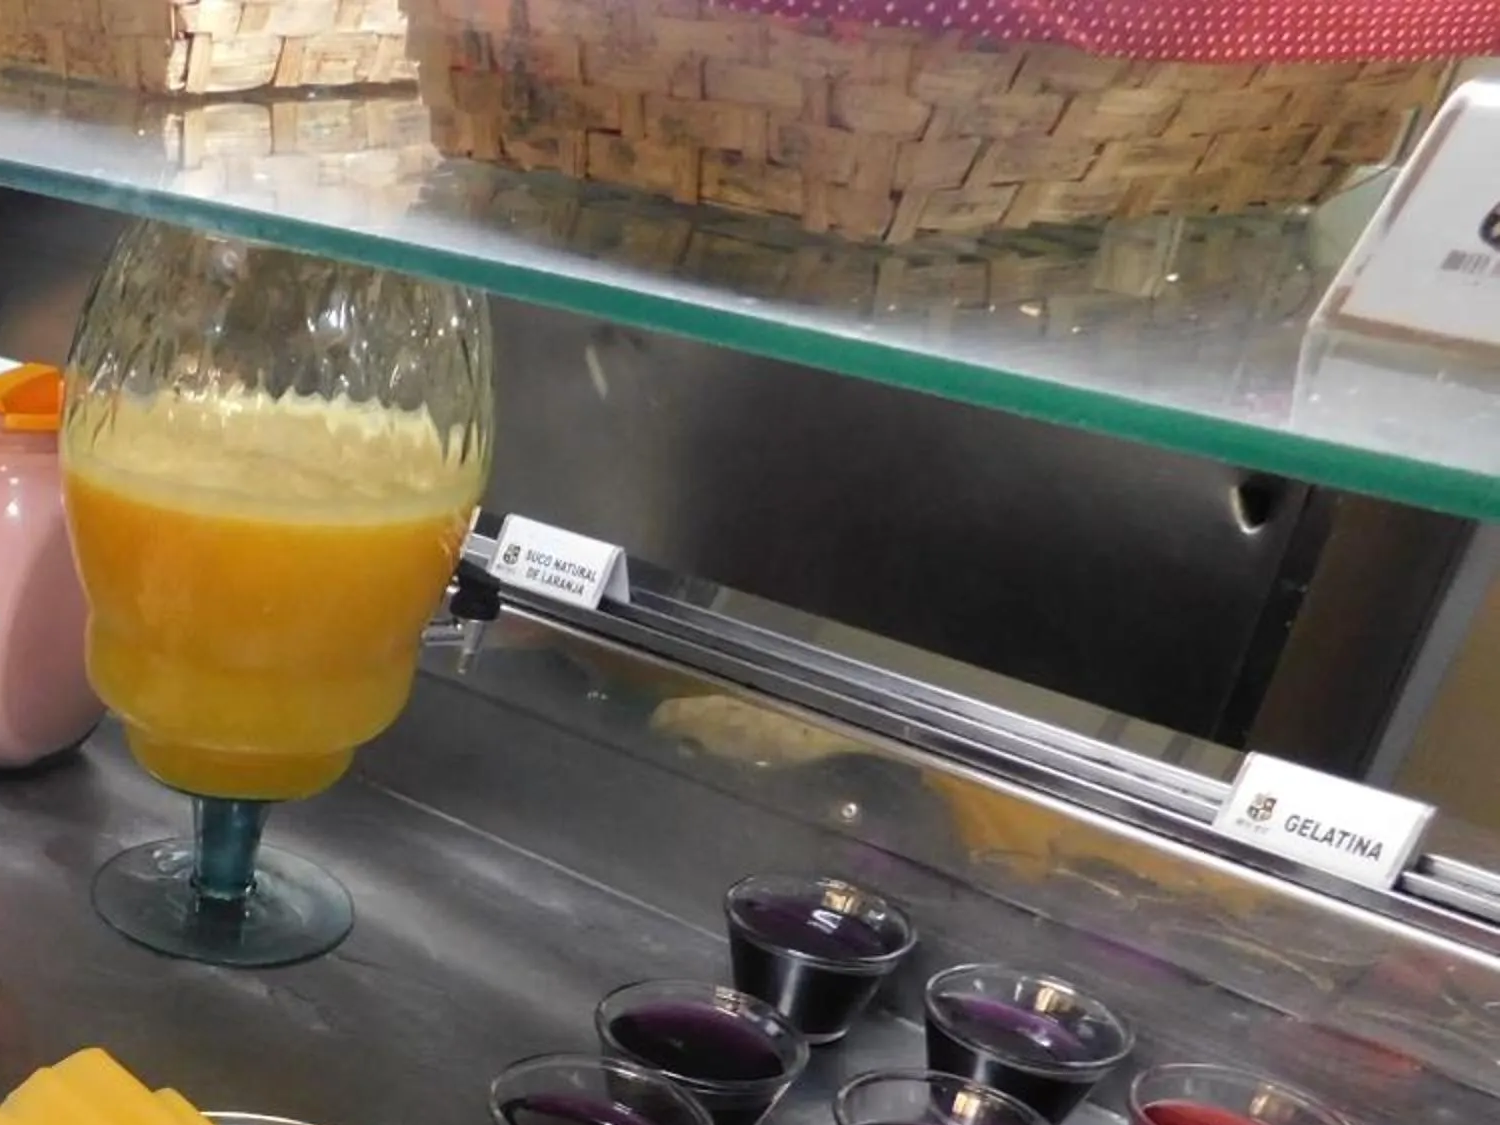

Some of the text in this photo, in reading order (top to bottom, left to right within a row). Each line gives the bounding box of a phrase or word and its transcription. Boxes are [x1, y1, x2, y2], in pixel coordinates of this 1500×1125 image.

[526, 549, 597, 583] SUCO NATURAL
[526, 567, 540, 581] DE
[541, 573, 584, 595] LARANJA
[1284, 814, 1384, 862] GELATINA
